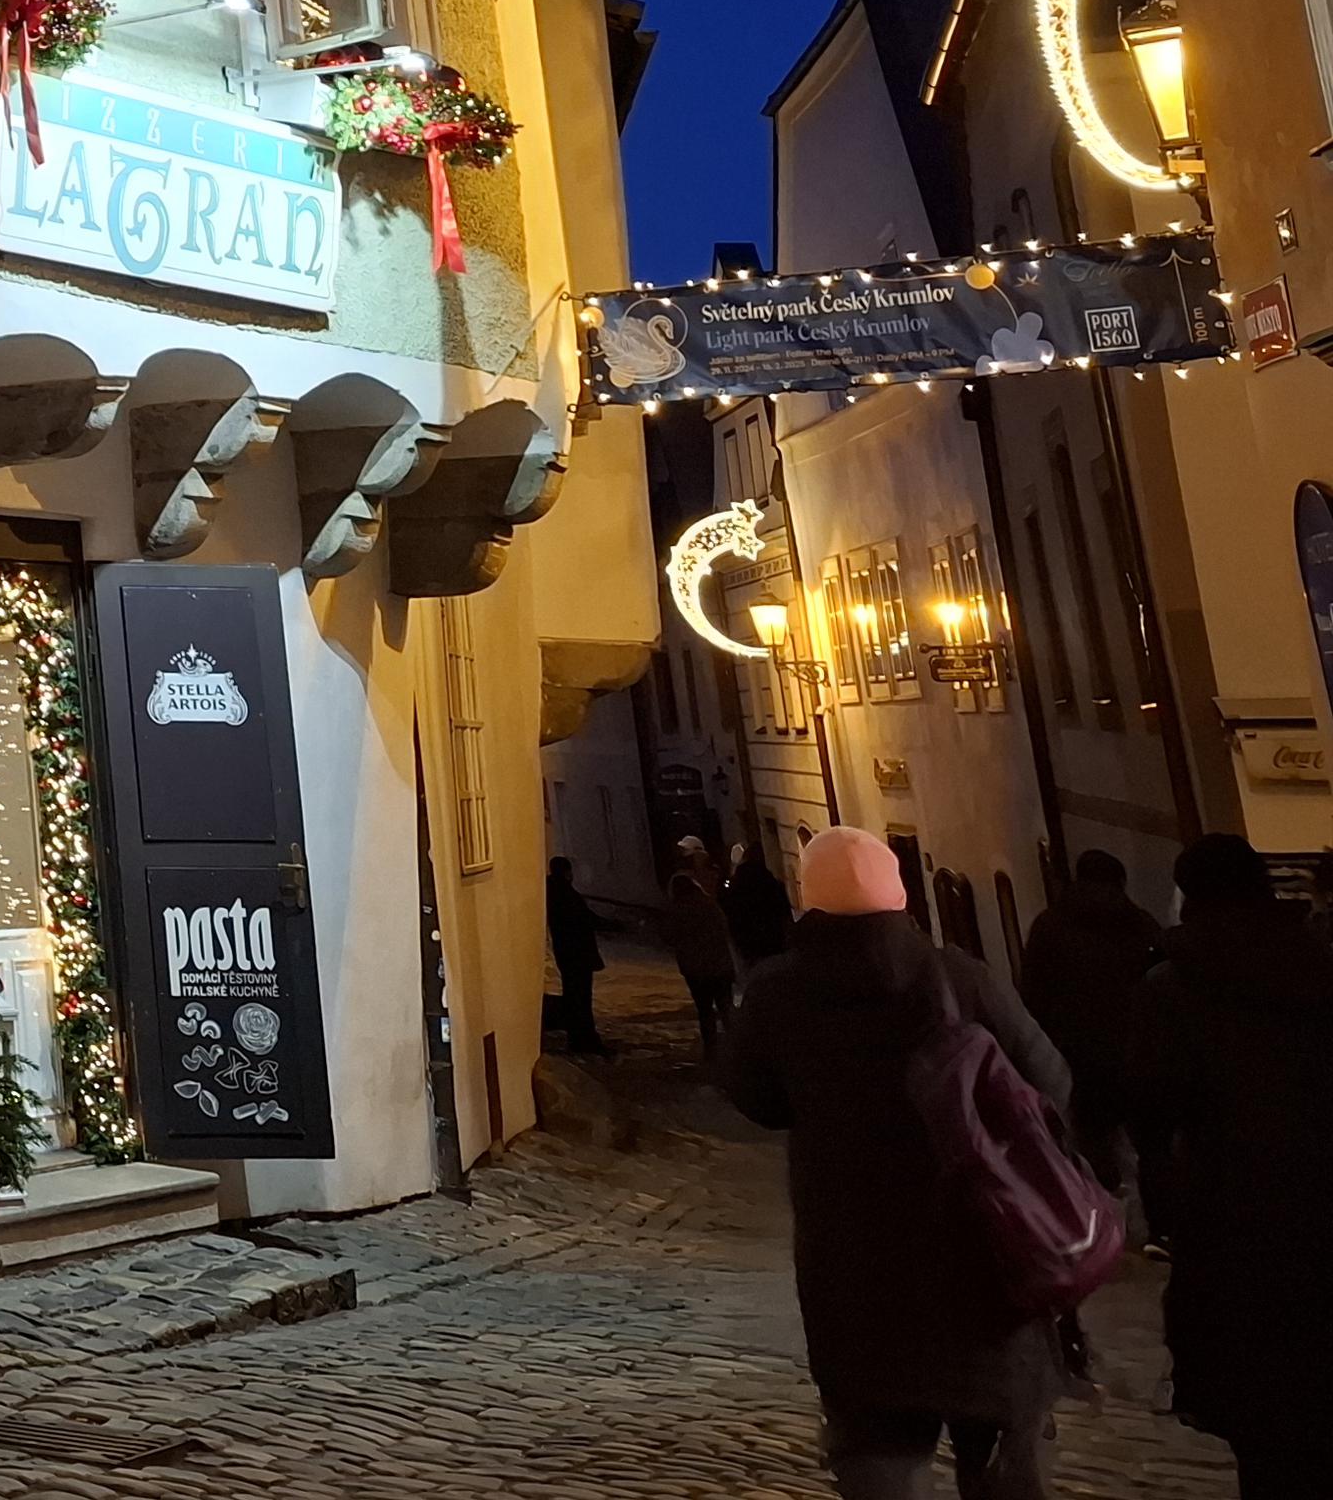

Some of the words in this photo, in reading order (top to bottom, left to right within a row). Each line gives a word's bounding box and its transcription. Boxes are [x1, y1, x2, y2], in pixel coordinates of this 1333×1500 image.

[20, 74, 325, 185] IZZERIA
[701, 299, 776, 325] Světelný
[777, 297, 819, 322] park
[819, 287, 874, 315] Český
[874, 282, 955, 309] Krumlov
[1193, 307, 1204, 319] m
[1091, 311, 1130, 331] PORT
[705, 329, 751, 352] Light
[752, 325, 796, 349] park
[797, 318, 853, 344] Český
[853, 312, 931, 338] Krumlov
[1093, 328, 1133, 348] 1560
[1195, 321, 1209, 343] 100
[166, 683, 226, 697] STELLA
[168, 698, 228, 711] ARTOIS
[162, 897, 276, 997] pasta
[181, 970, 221, 984] DOMÁCÍ
[222, 970, 278, 985] TĚSTOVINY
[182, 984, 229, 997] ITALSKÉ
[229, 983, 281, 998] KUCHYNĚ
